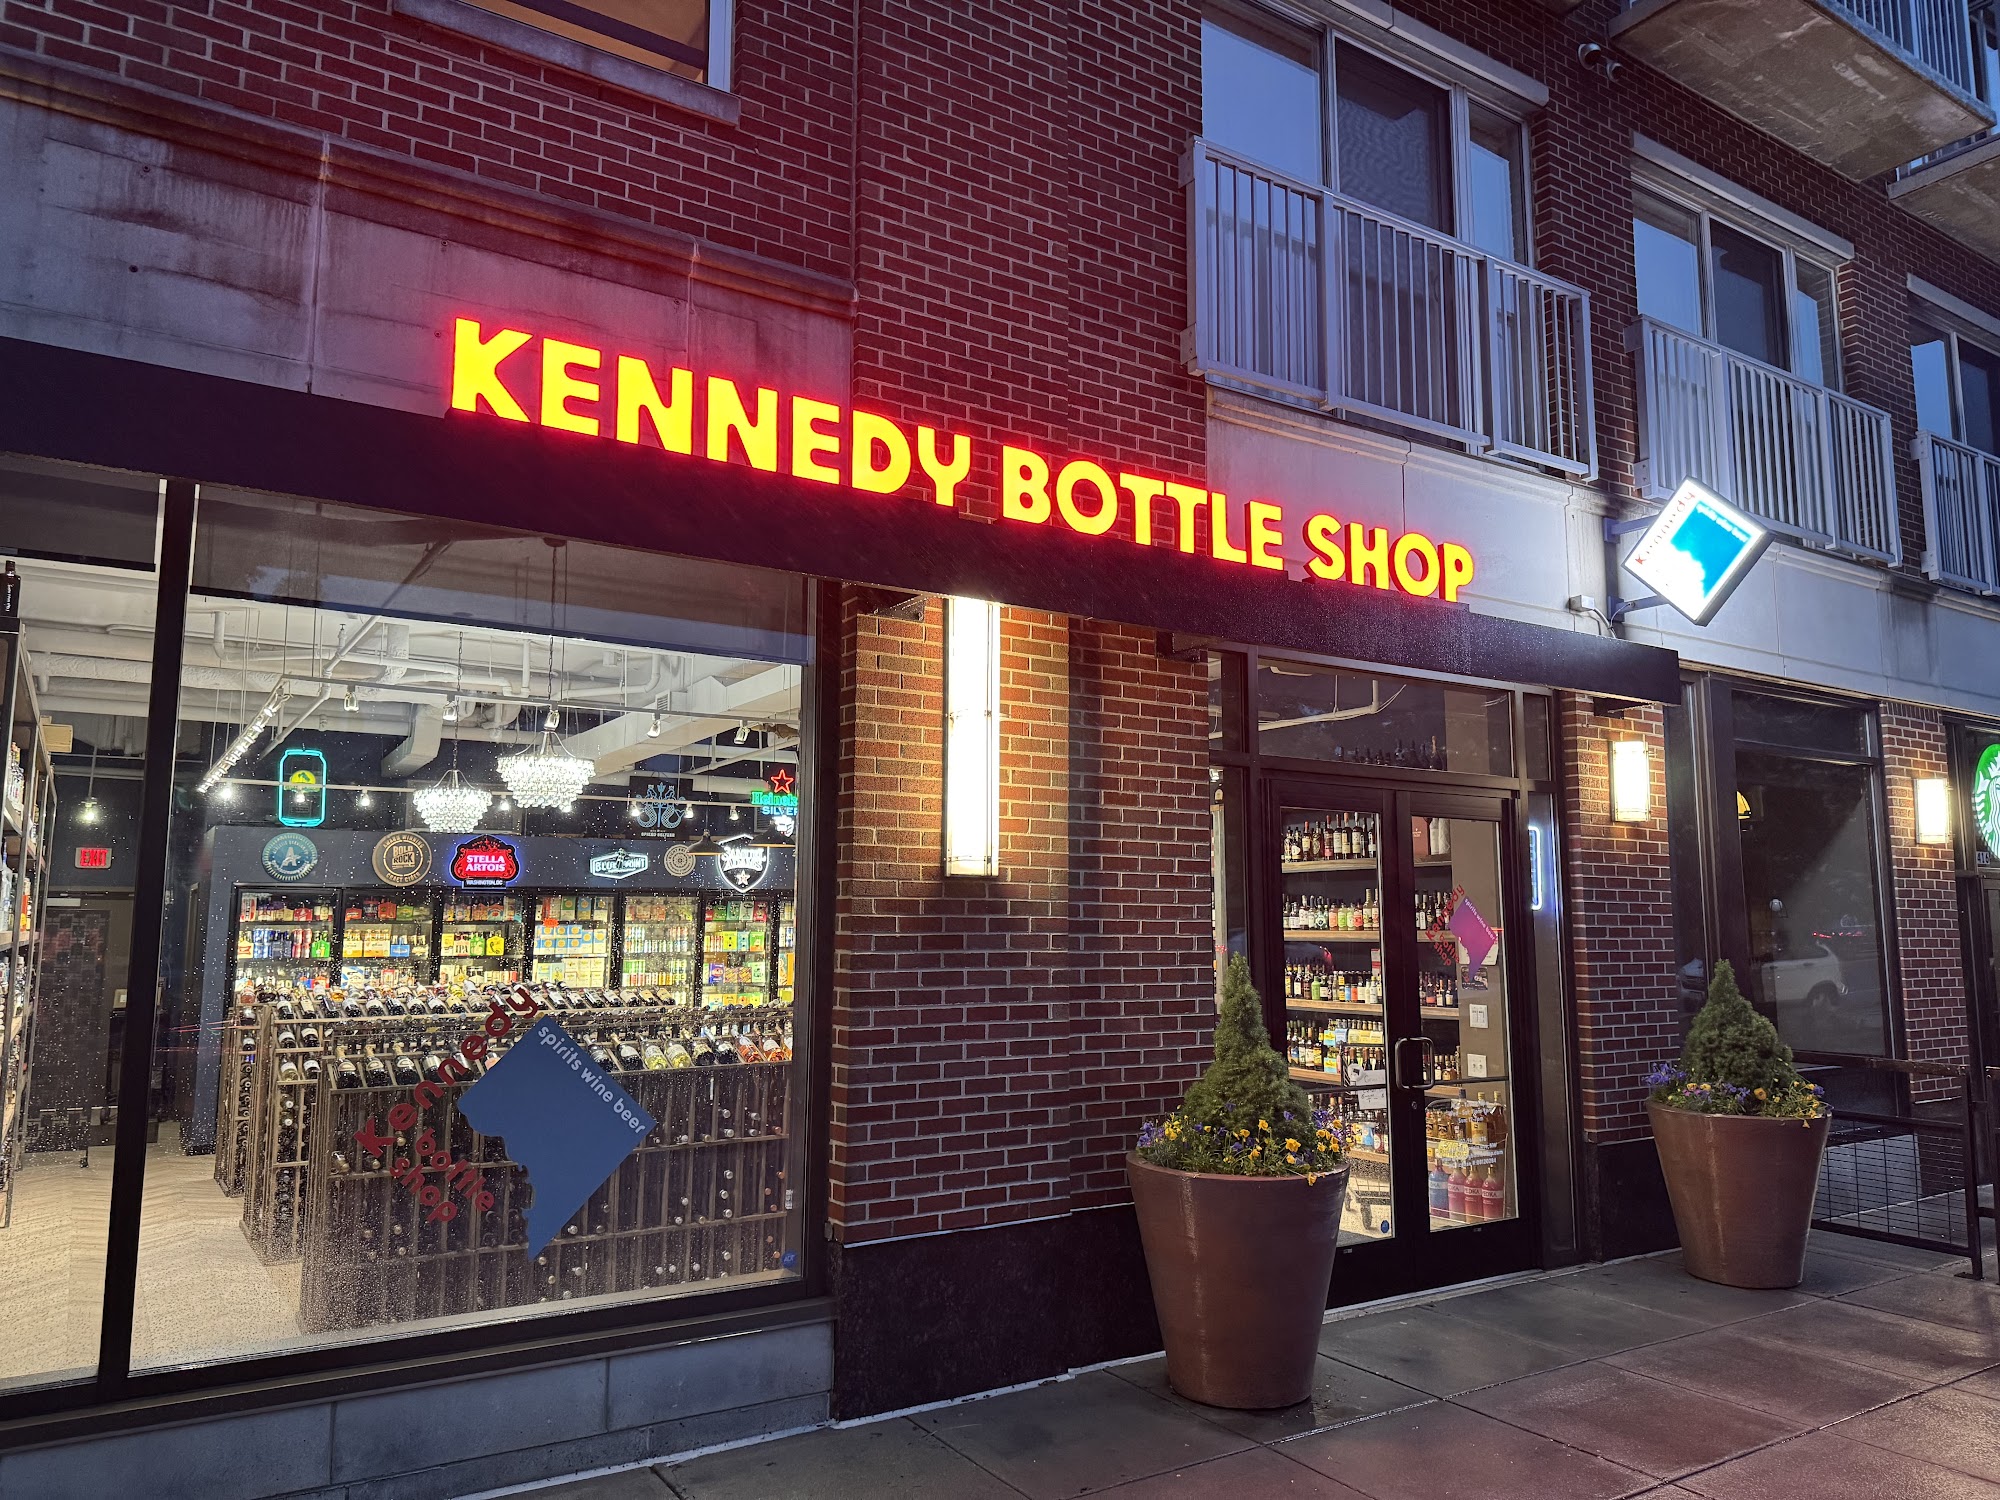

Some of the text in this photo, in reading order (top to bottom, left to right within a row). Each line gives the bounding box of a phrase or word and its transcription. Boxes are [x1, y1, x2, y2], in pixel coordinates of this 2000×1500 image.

[452, 318, 1475, 602] KENNEDY BOTTLE SHOP
[81, 849, 108, 866] EXIT
[393, 845, 414, 857] BOLD
[393, 853, 414, 864] ROCK
[466, 855, 505, 863] STELLA
[466, 863, 506, 872] ARTOIS
[1425, 884, 1465, 940] Kennedy
[1433, 943, 1452, 966] shop
[354, 987, 539, 1158] Kennedy
[538, 1025, 645, 1135] spirits wine beer
[415, 1128, 494, 1211] bottle
[389, 1157, 457, 1223] shop
